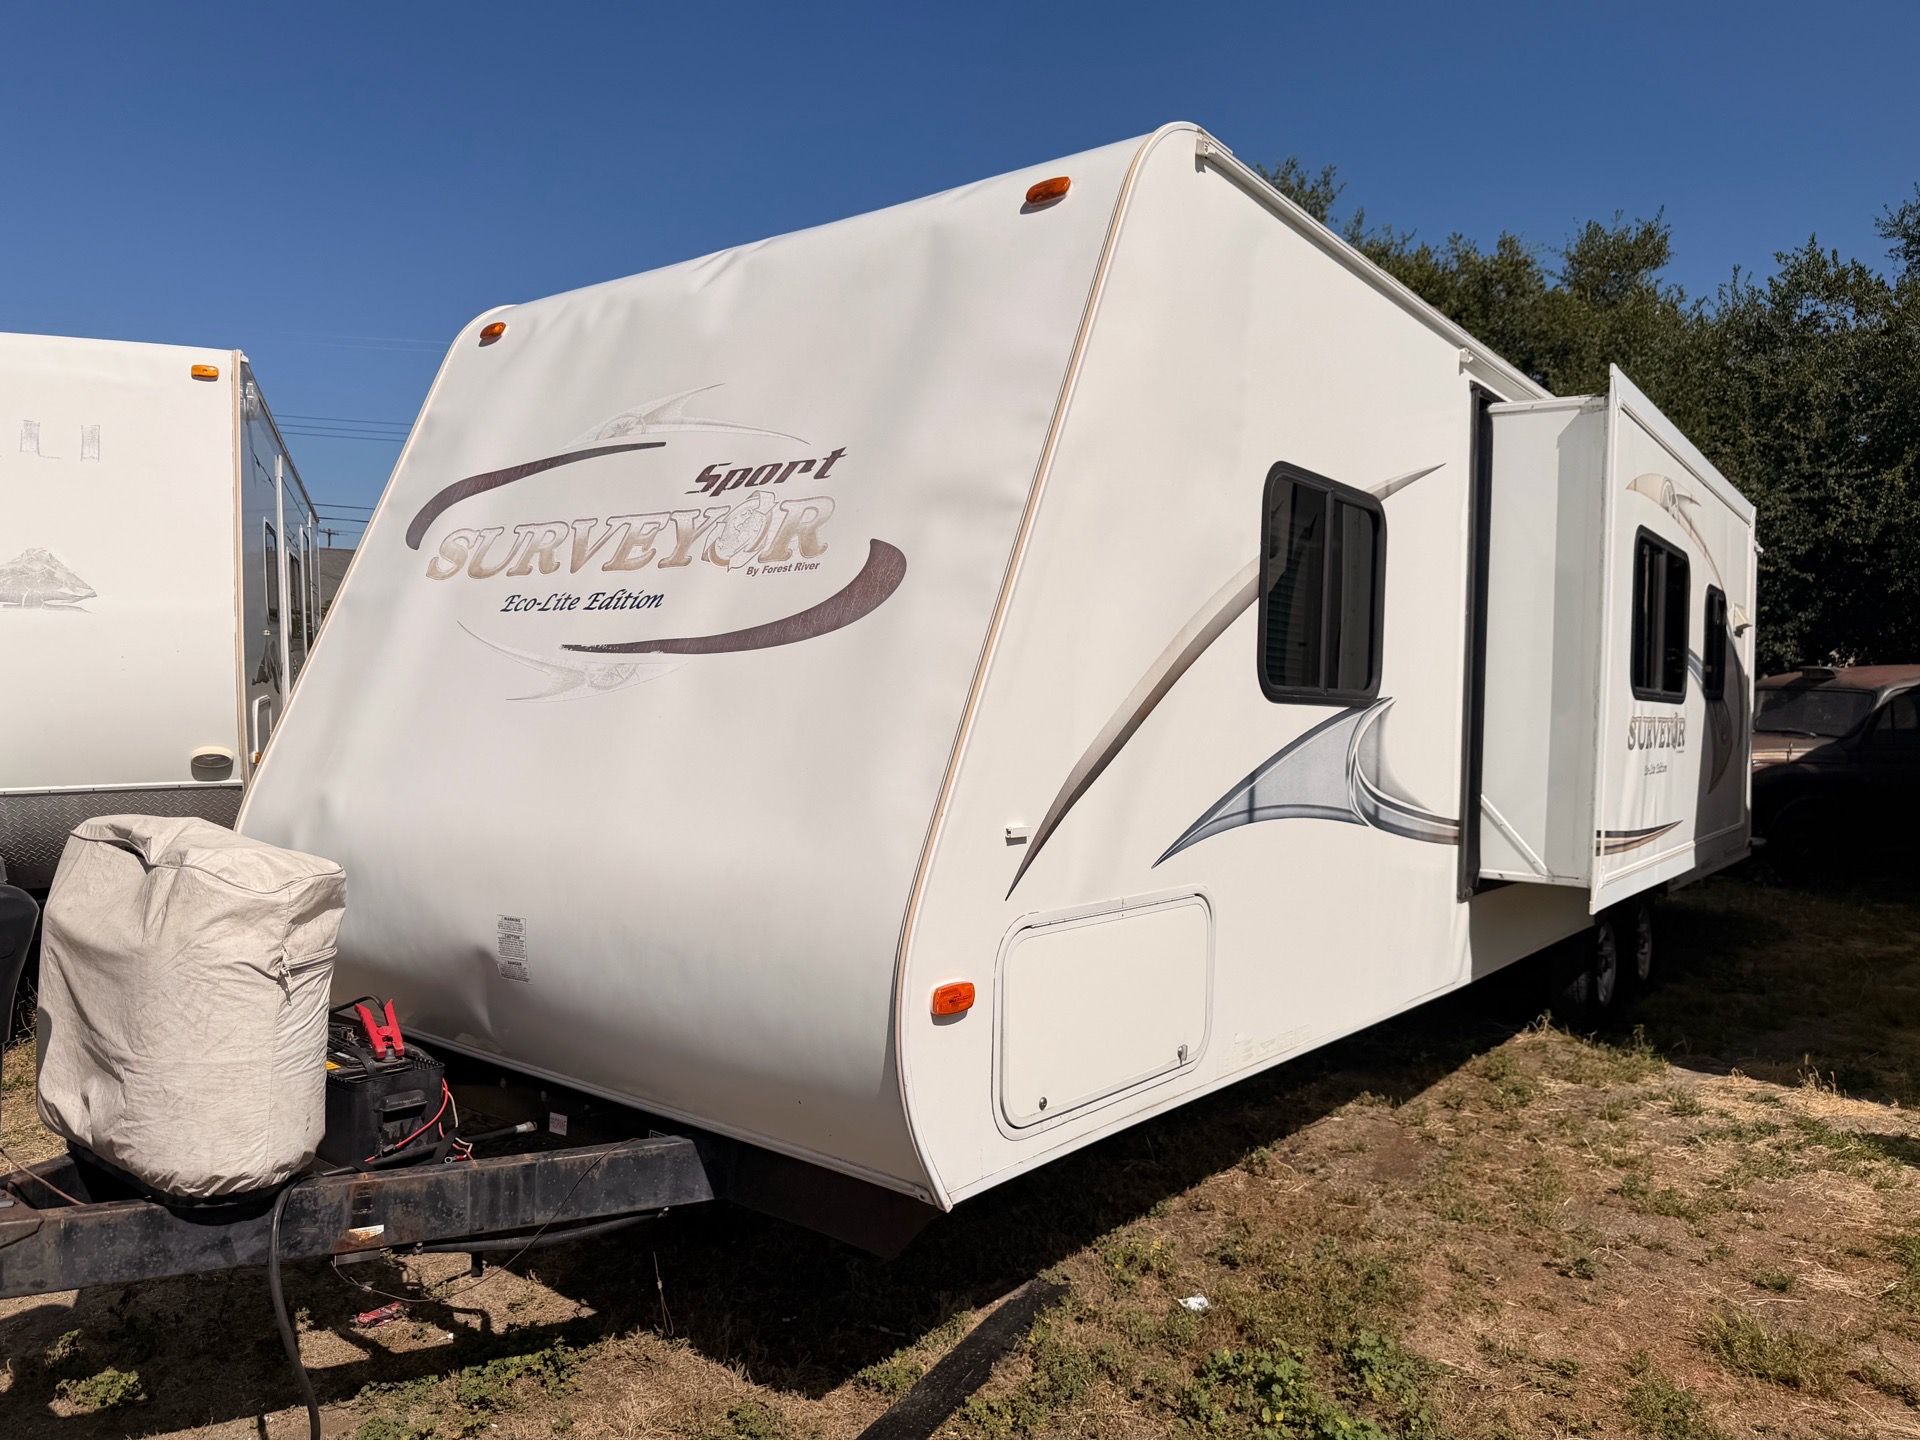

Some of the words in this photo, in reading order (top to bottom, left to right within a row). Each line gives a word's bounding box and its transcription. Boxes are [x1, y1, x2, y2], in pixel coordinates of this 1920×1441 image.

[684, 446, 848, 498] Sport
[425, 491, 836, 580] SURVEYOR
[746, 566, 760, 577] By
[761, 563, 793, 574] Forest
[793, 561, 820, 572] River
[499, 591, 581, 613] Eco-Lite
[583, 588, 665, 611] Edition
[1627, 713, 1686, 751] SURVEYOR
